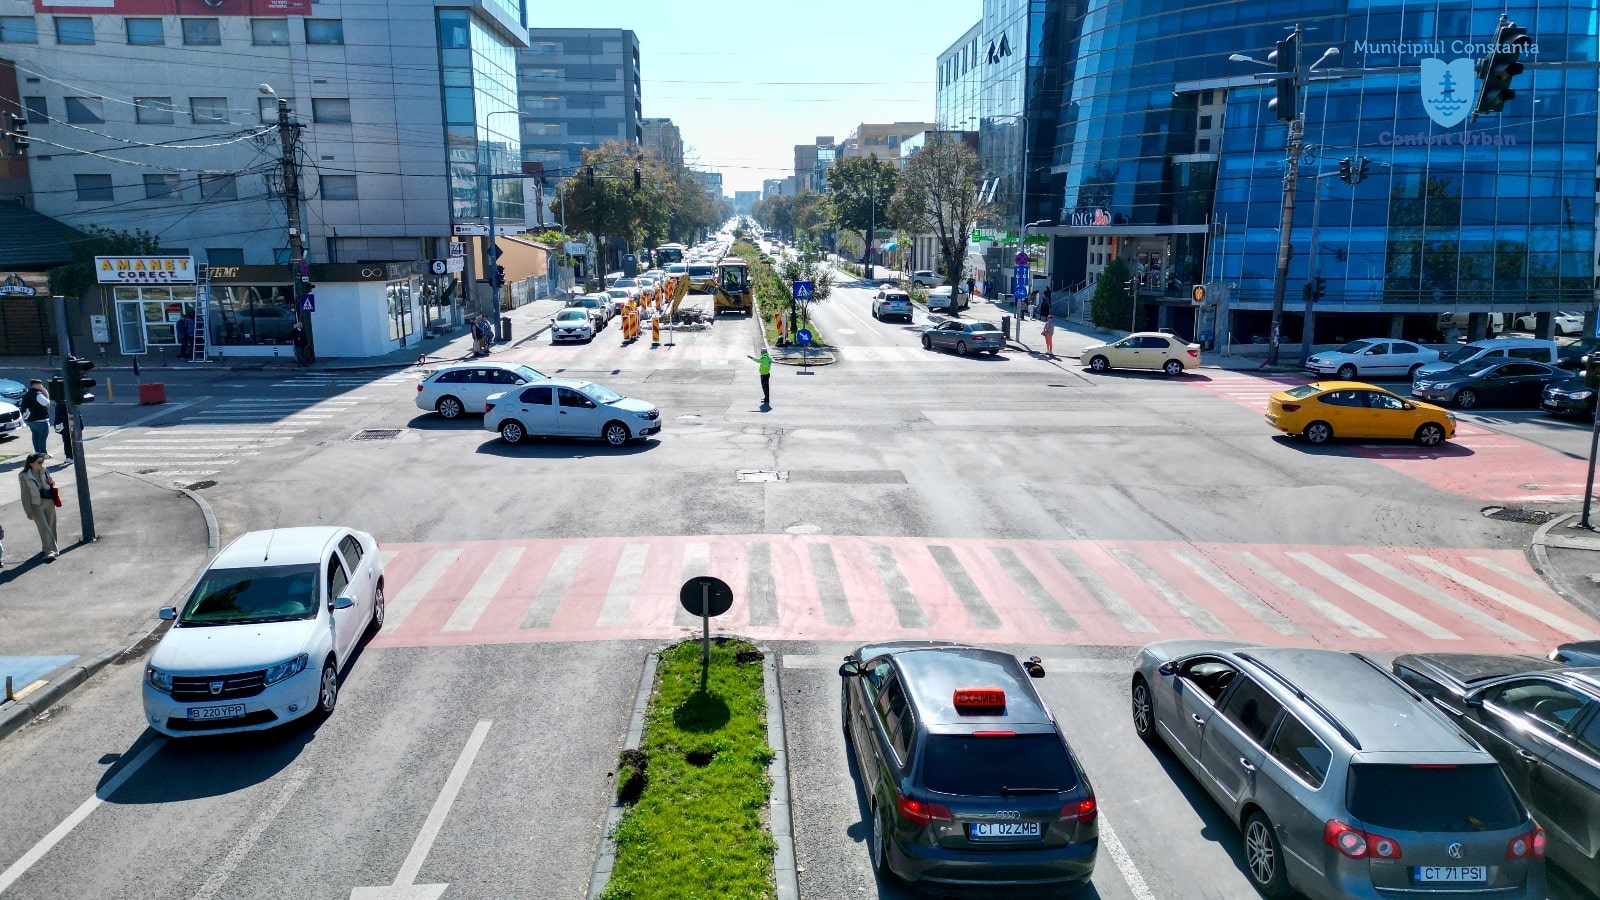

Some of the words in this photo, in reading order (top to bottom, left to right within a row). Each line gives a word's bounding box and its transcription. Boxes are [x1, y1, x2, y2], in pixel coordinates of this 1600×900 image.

[1071, 212, 1093, 226] ING
[101, 259, 189, 271] AMANET
[958, 693, 1003, 704] EXAMEN
[193, 709, 200, 718] B
[979, 823, 993, 835] CT
[1425, 867, 1440, 879] CT
[1445, 867, 1457, 879] 71
[1461, 867, 1482, 879] PSI
